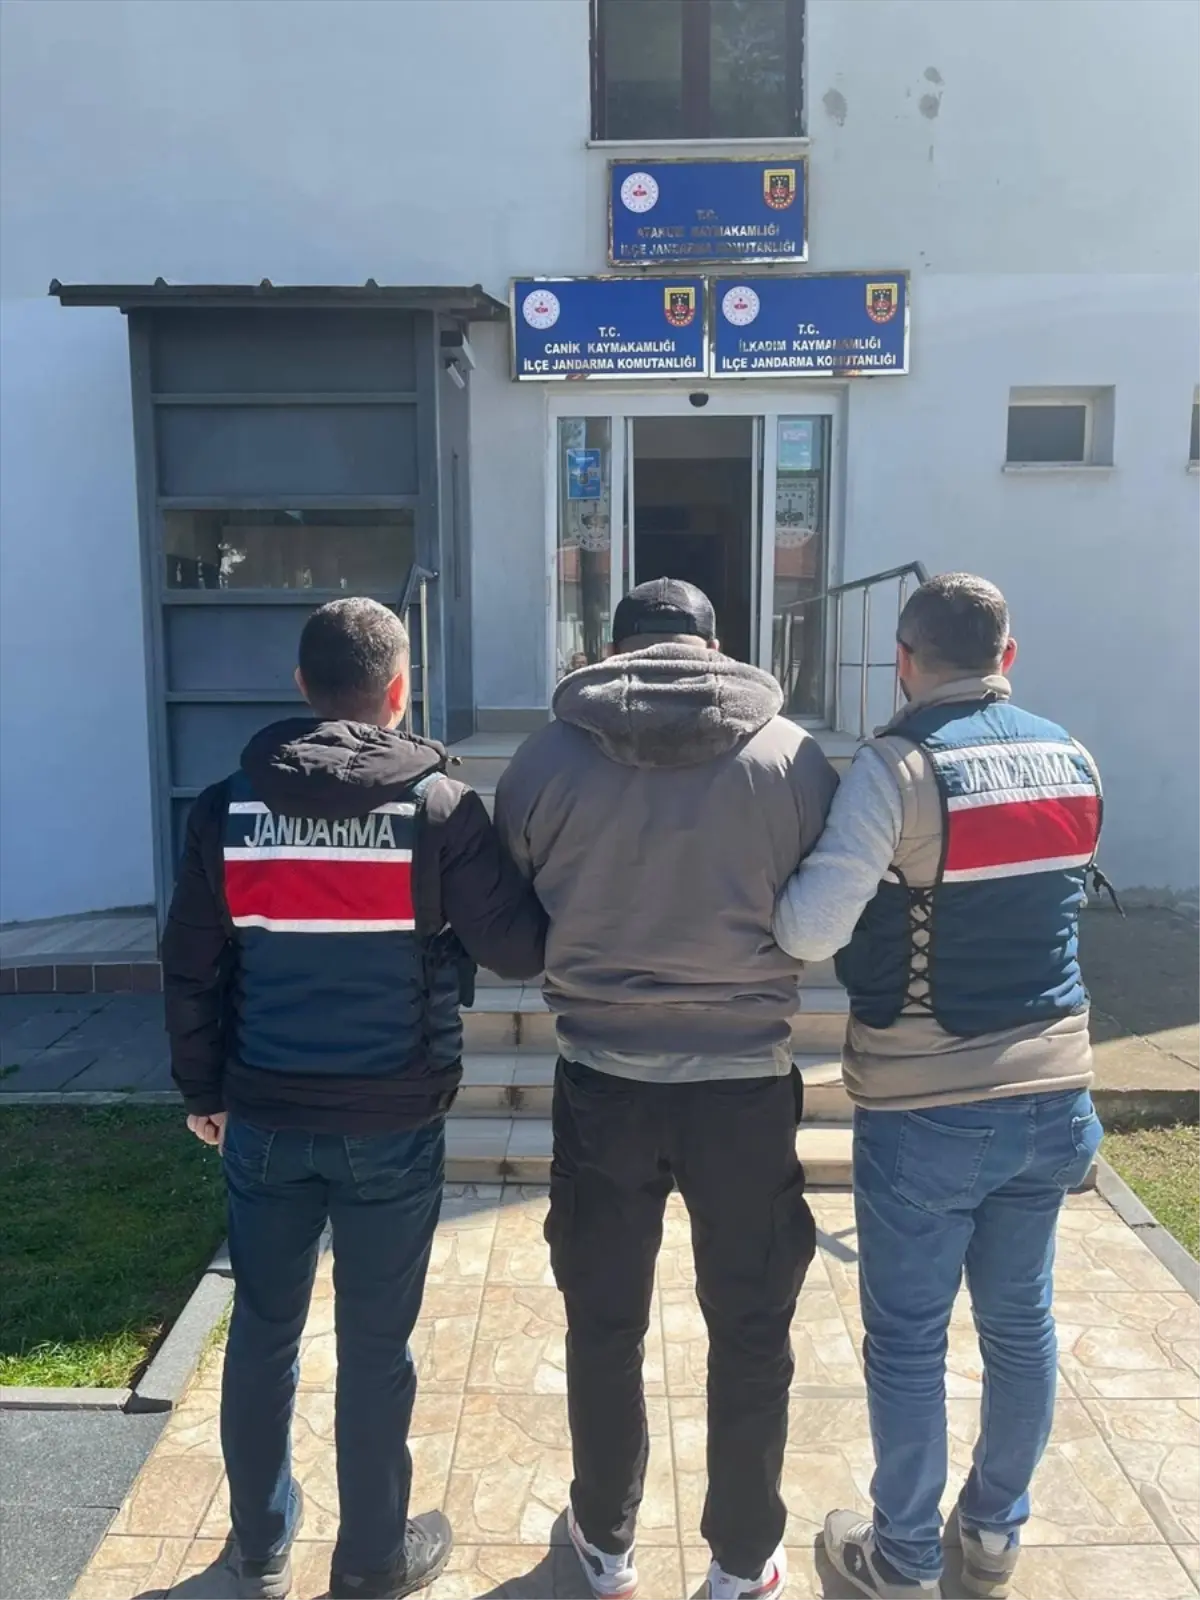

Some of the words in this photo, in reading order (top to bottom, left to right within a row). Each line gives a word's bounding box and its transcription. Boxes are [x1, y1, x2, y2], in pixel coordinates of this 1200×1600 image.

[598, 326, 621, 338] T.C.
[797, 323, 820, 335] T.C.
[544, 341, 581, 355] CANİK
[587, 339, 676, 353] KAYMAKAMLIĞI
[792, 335, 882, 351] KAYMAMLIĞI
[523, 357, 549, 373] İLÇE
[552, 358, 614, 371] JANDARMA
[617, 355, 697, 369] KOMUTANLIĞI
[722, 355, 748, 371] İLÇE
[751, 355, 814, 369] JANDARMA
[960, 752, 1081, 794] JANDARMA
[243, 812, 396, 848] JANDARMA
